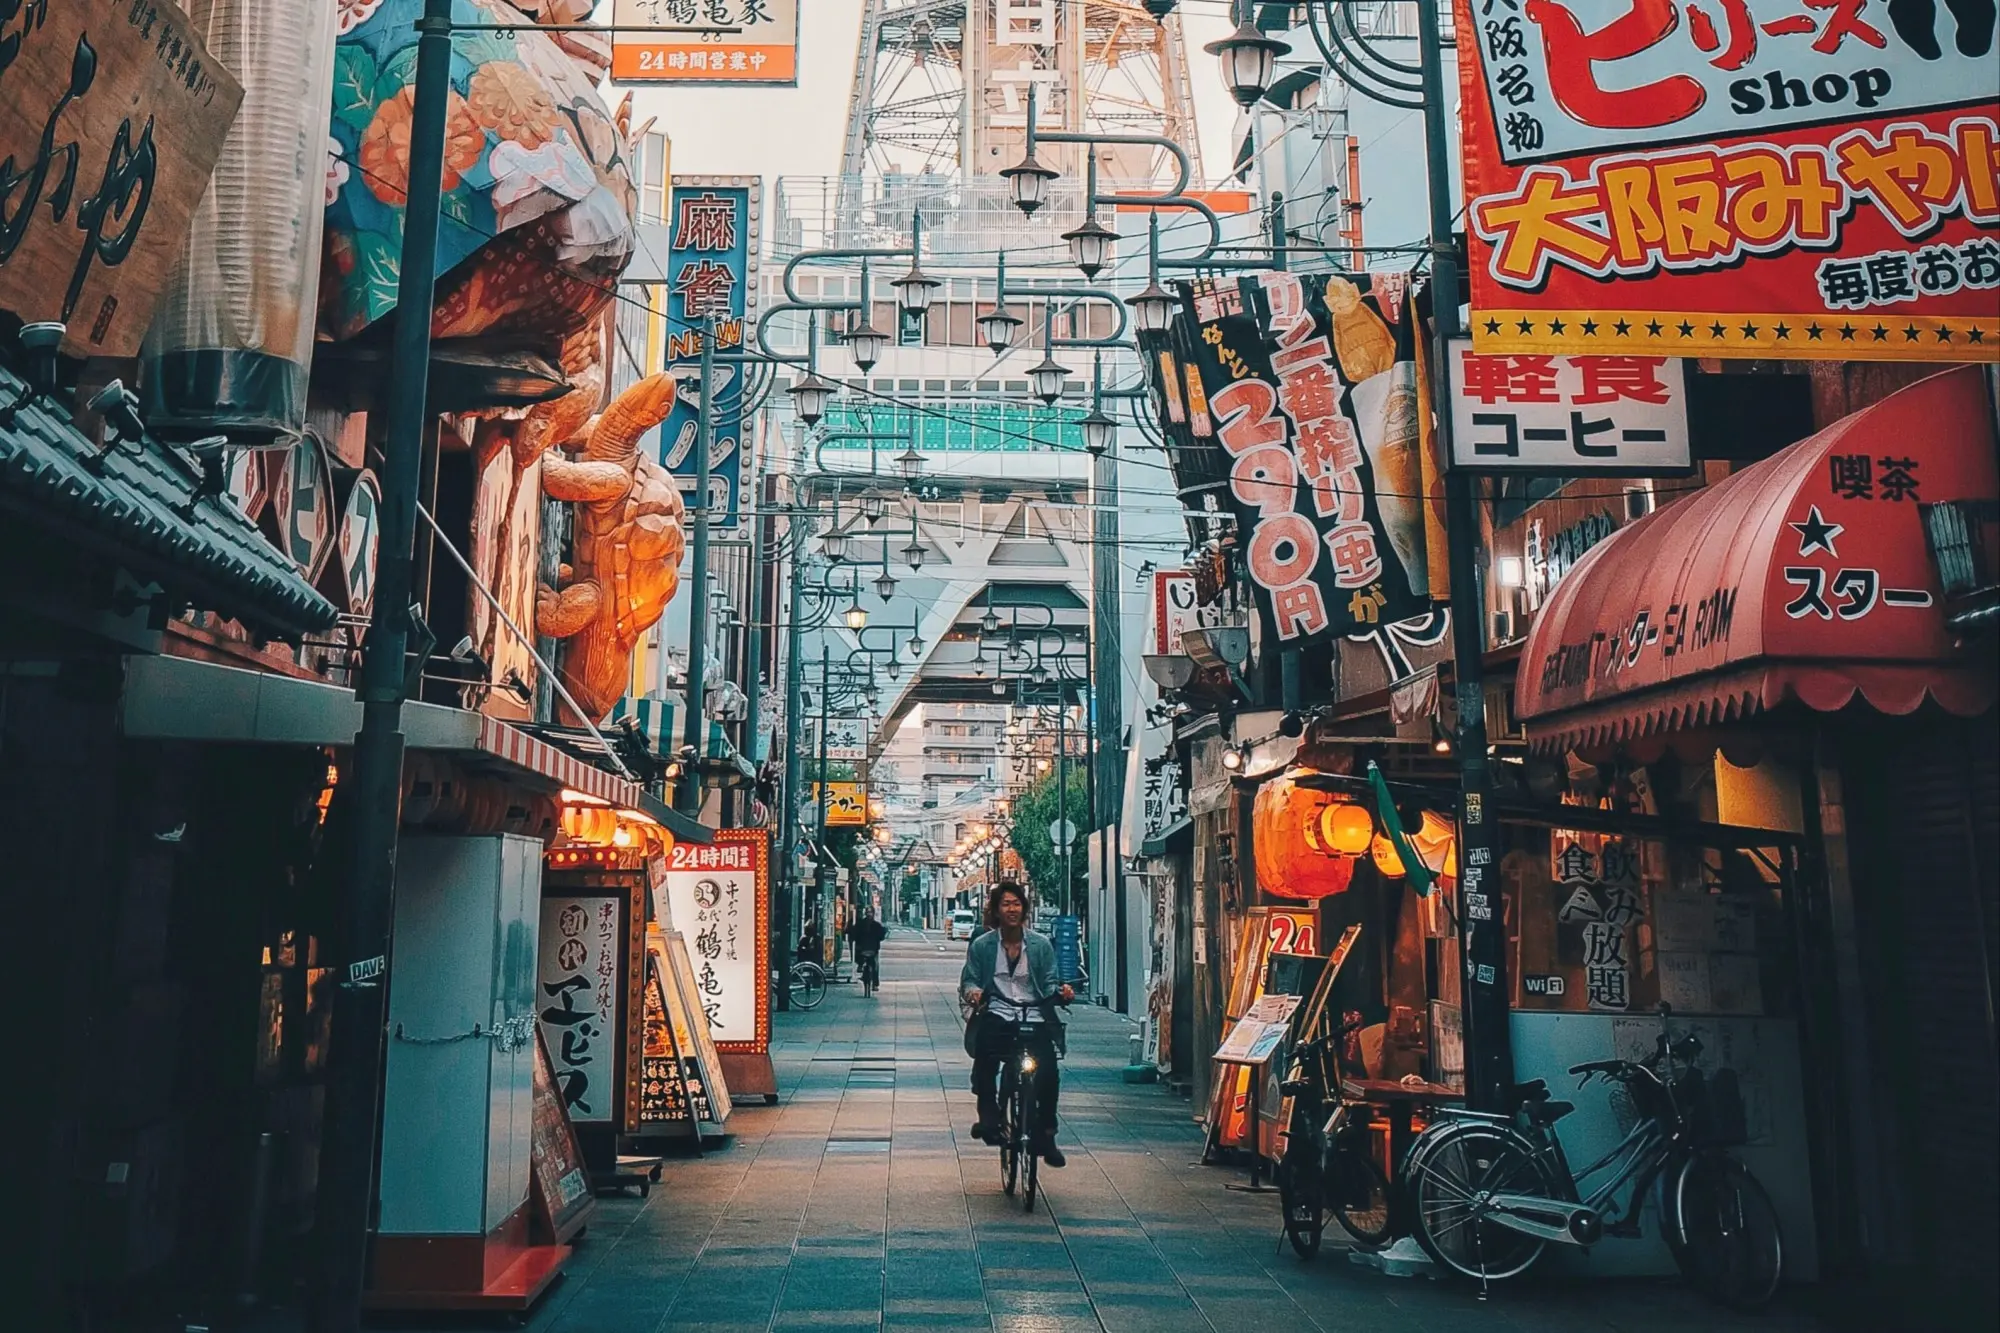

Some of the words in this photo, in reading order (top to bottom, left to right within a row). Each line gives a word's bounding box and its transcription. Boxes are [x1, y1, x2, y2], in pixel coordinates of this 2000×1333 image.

[639, 50, 768, 71] 24時間営業中
[670, 191, 739, 319] 麻雀
[668, 316, 744, 361] NEW
[1461, 350, 1673, 405] 軽食
[1471, 410, 1667, 458] コーヒー
[1829, 453, 1921, 501] 喫茶
[1783, 566, 1934, 621] スター
[671, 846, 737, 869] 24時間
[1269, 915, 1315, 956] 24
